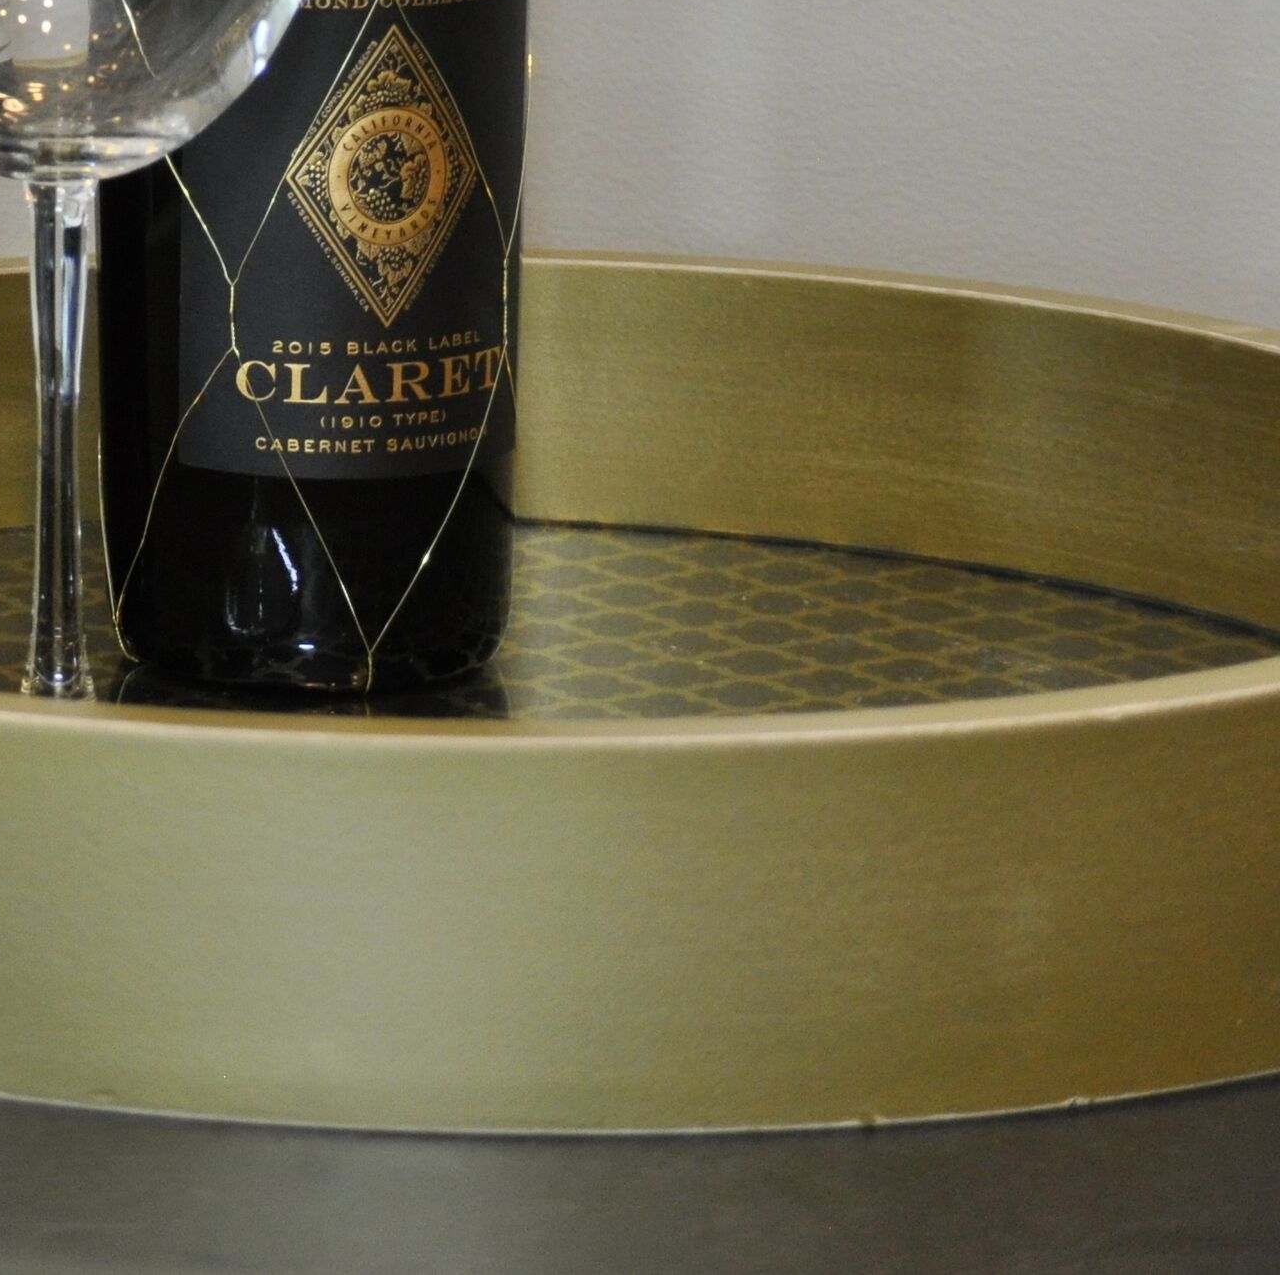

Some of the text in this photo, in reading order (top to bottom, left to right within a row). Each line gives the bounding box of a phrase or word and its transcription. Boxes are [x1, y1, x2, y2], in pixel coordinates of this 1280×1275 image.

[342, 114, 438, 152] CALIFORNIA
[340, 199, 438, 238] VINEYARDS
[272, 330, 481, 355] 2015 BLACK LABEL
[235, 345, 504, 405] CLARET
[255, 426, 488, 454] CABERNET SAUVIGNON
